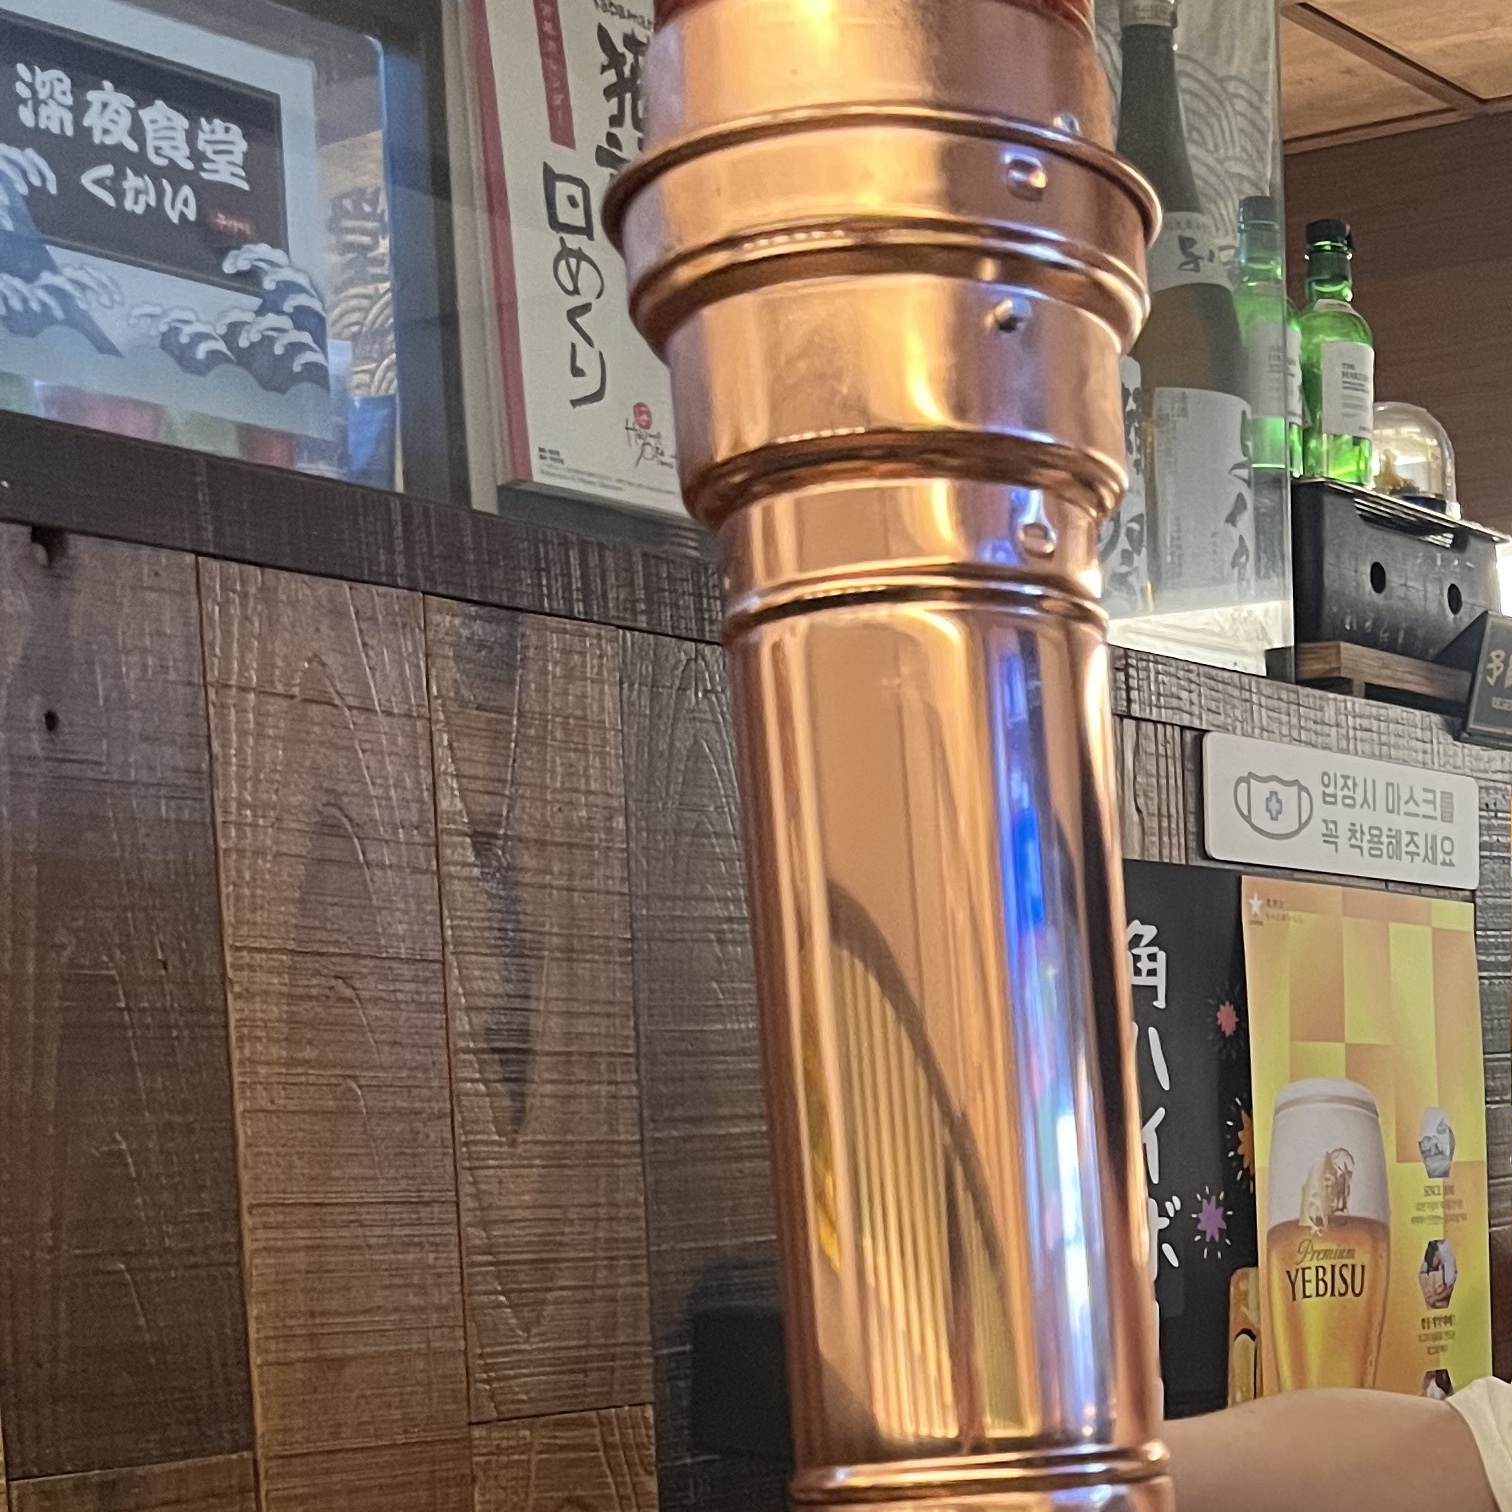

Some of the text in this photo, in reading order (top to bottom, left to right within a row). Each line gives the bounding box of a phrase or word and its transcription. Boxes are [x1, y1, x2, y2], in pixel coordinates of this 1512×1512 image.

[15, 62, 250, 192] 深夜食堂
[1320, 771, 1377, 812] 입장시
[1321, 818, 1456, 868] 꼭 착용해주세요
[1127, 919, 1181, 1370] 角ハイボ
[1295, 1238, 1356, 1265] Premium
[1285, 1263, 1366, 1302] YEBISU
